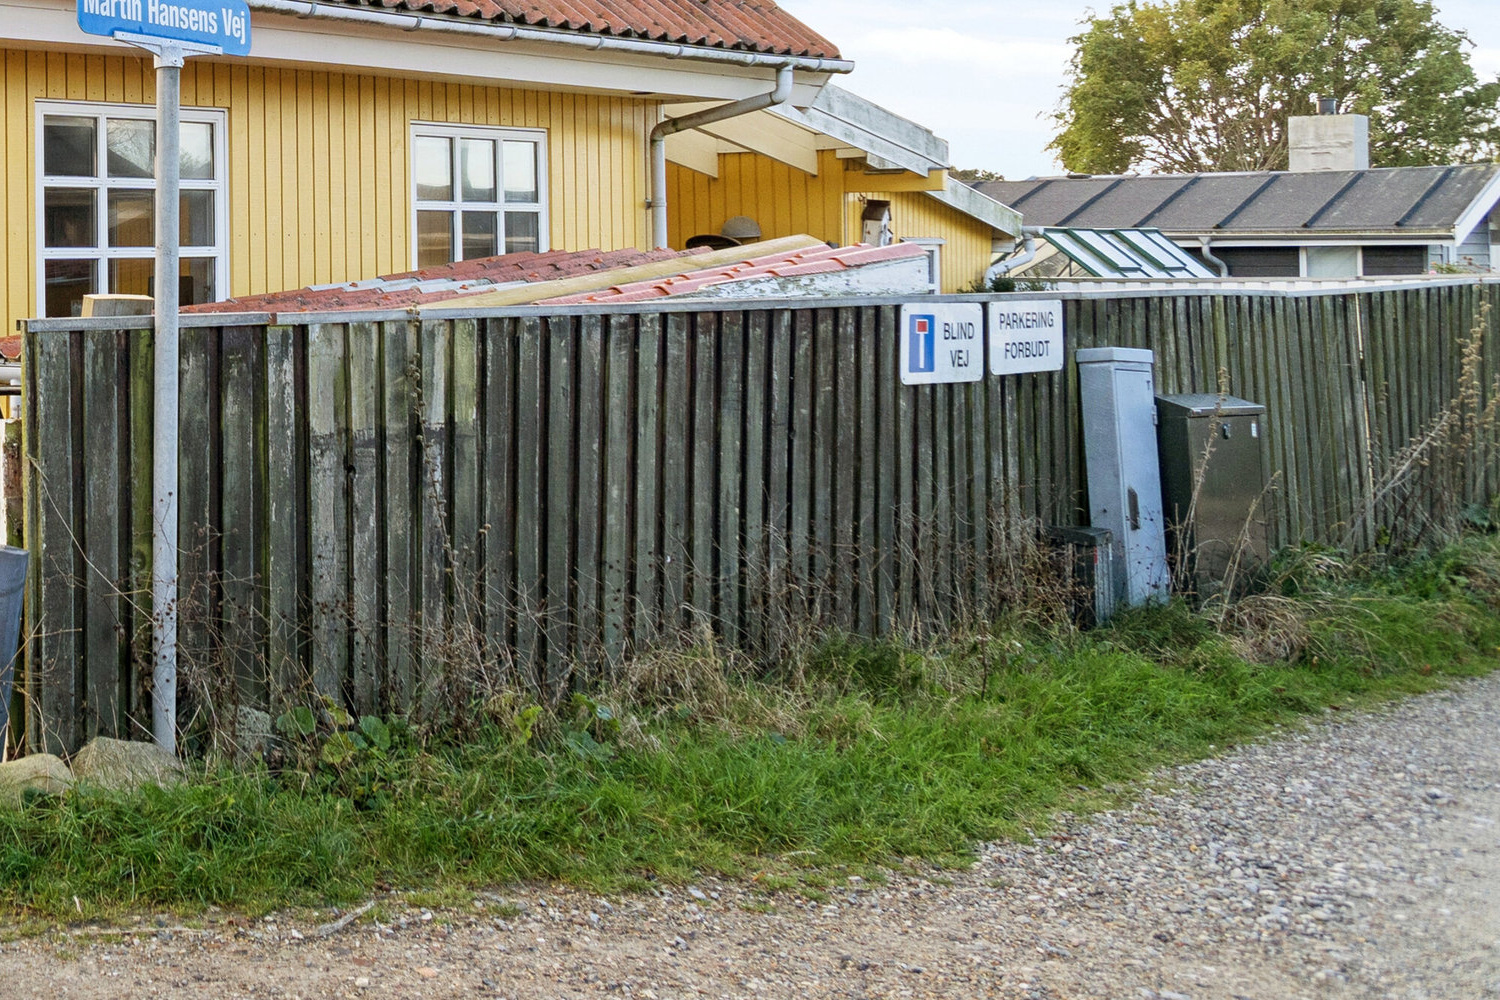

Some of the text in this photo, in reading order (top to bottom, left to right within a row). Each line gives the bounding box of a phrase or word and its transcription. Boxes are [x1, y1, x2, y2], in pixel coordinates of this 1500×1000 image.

[221, 7, 246, 45] Vej
[1000, 311, 1054, 330] PARKERING
[943, 322, 975, 340] BLIND
[950, 350, 969, 367] VEJ
[1004, 340, 1050, 359] FORBUDT
